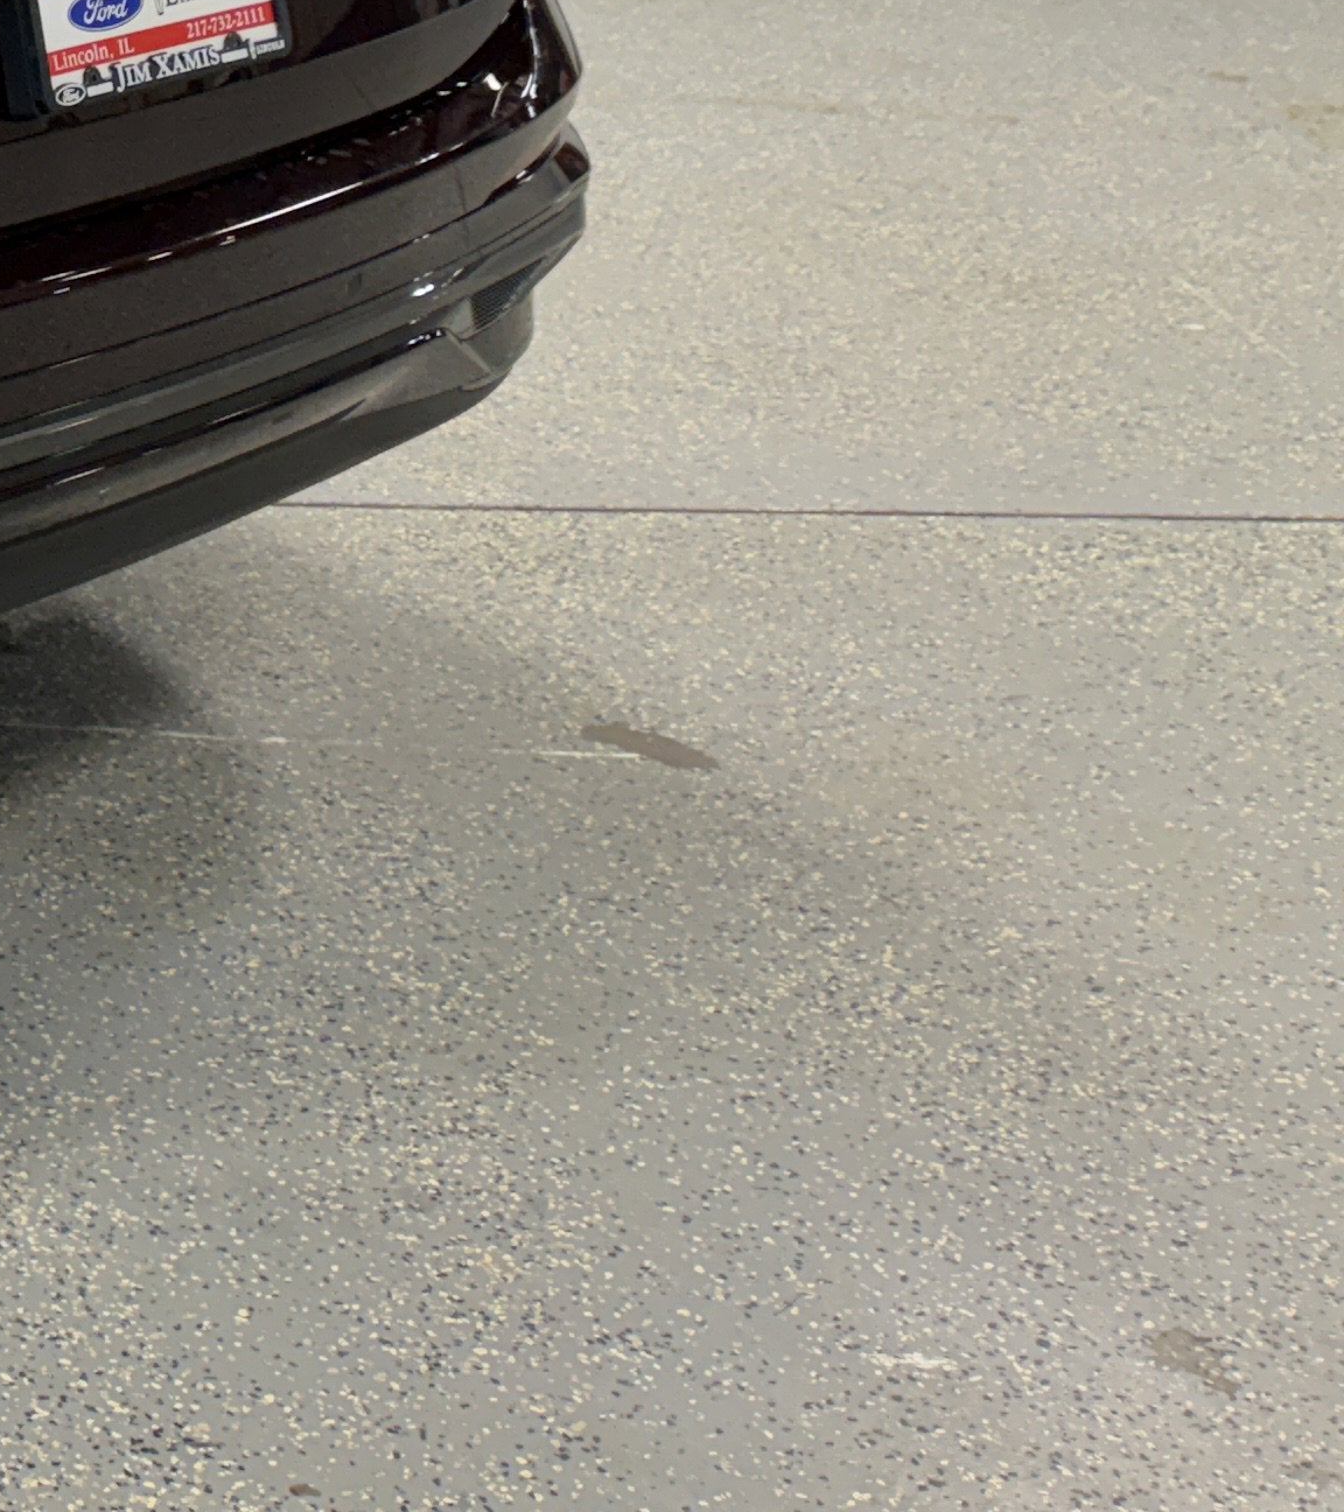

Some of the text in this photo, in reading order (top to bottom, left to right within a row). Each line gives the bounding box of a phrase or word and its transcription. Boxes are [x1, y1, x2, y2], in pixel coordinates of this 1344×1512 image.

[186, 6, 266, 40] 217-732-2111
[117, 37, 135, 56] IL
[114, 45, 221, 93] JIM XAMIS
